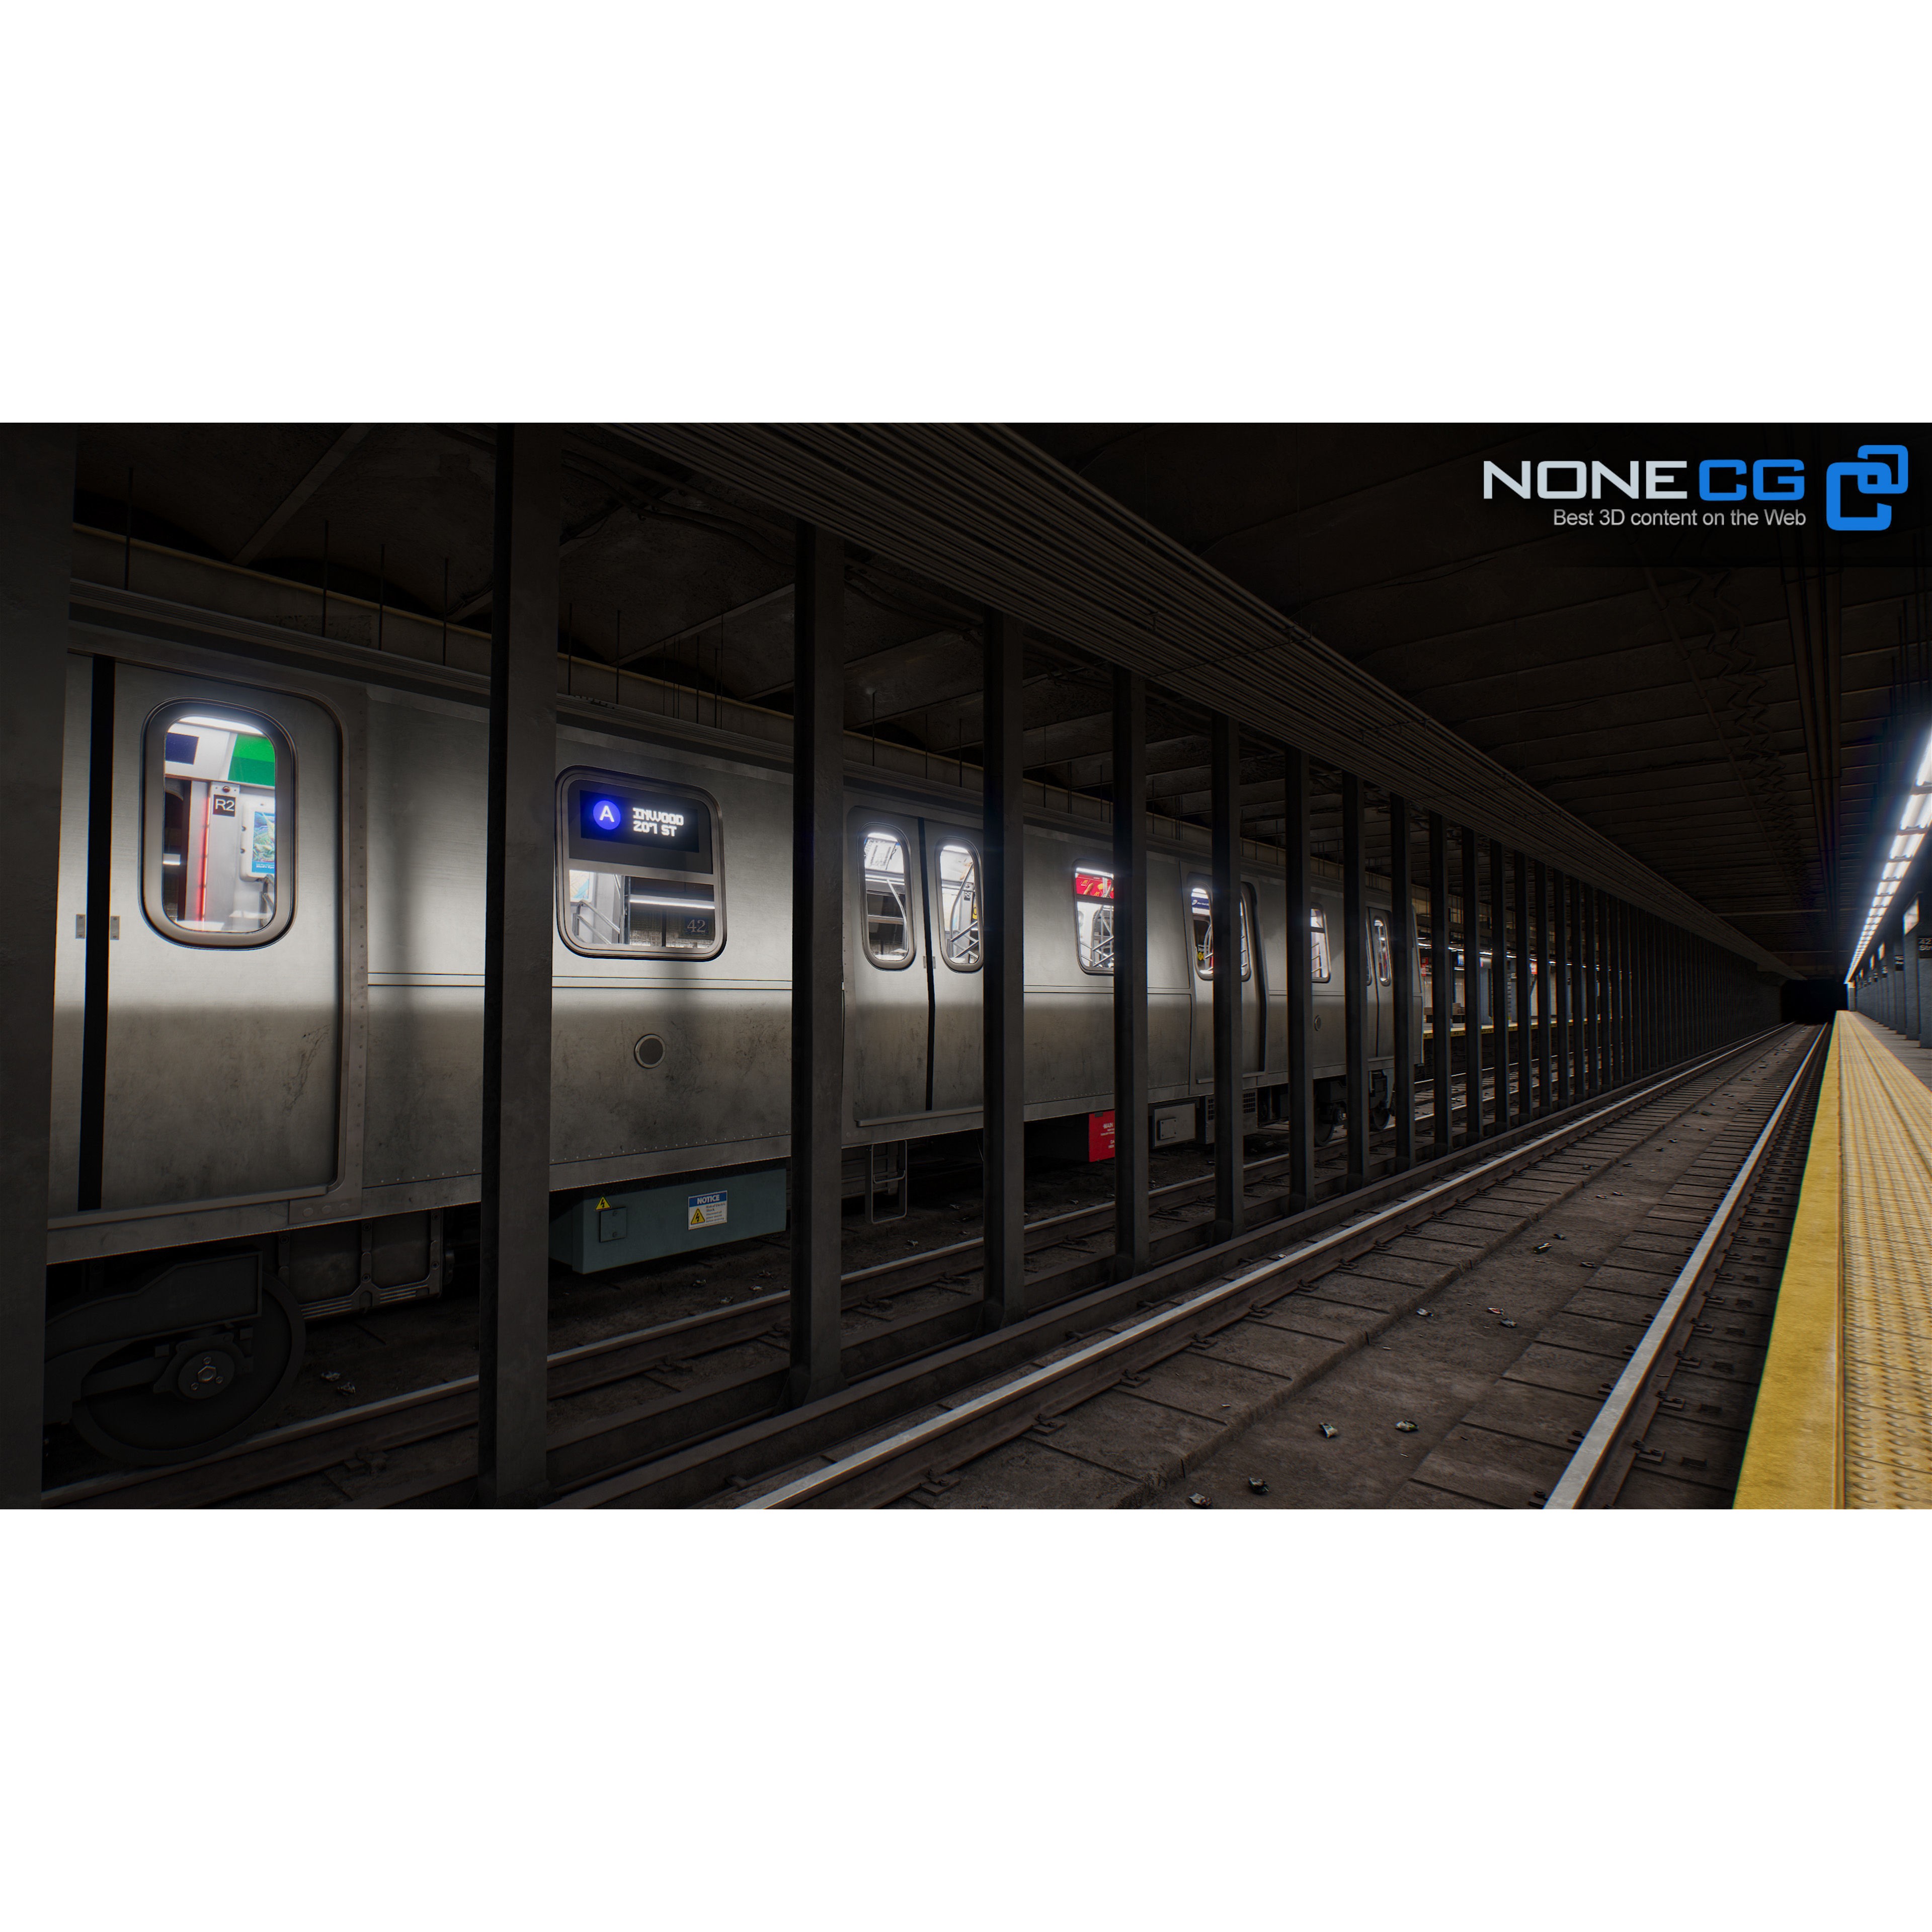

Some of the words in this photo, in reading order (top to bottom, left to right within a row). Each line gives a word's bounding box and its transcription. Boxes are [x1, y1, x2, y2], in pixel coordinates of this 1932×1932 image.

[215, 798, 234, 812] R2
[599, 805, 615, 823] A
[632, 808, 684, 826] INWOOD
[633, 821, 658, 834] 207
[661, 824, 677, 837] ST
[687, 919, 706, 933] 42
[697, 1194, 720, 1204] NOTICE
